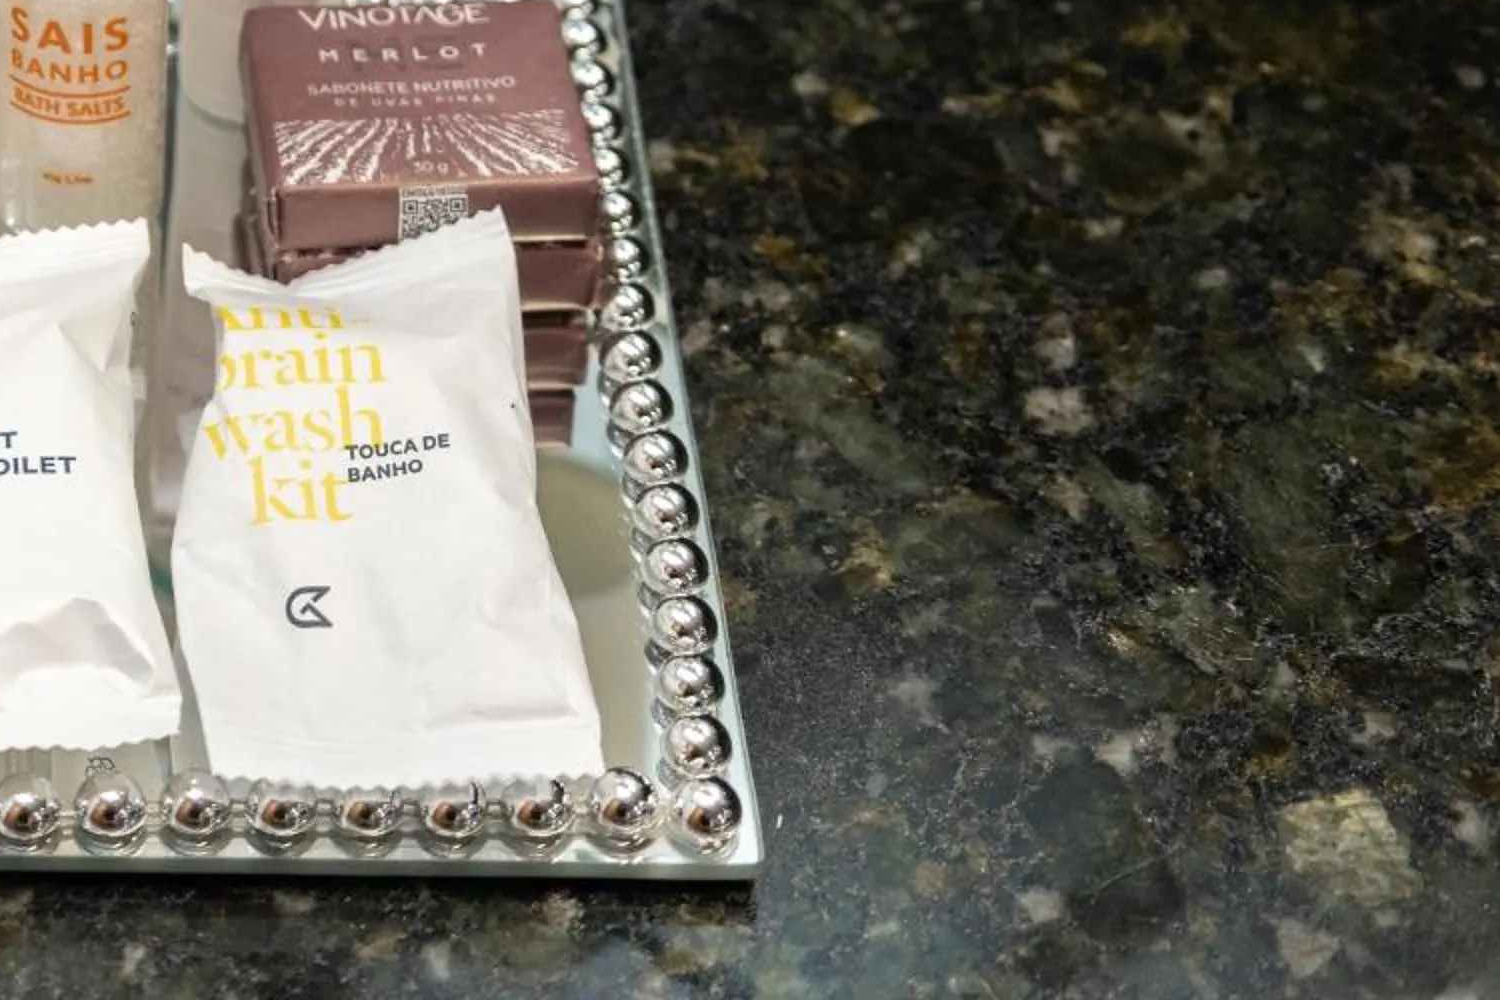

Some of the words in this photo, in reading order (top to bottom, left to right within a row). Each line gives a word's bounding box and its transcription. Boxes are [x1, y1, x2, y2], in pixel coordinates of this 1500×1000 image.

[10, 6, 130, 55] SAIS
[297, 3, 490, 31] VINOTAGE
[10, 48, 129, 84] BANHO
[318, 42, 486, 62] MERLOT
[307, 81, 409, 97] SABONETE
[413, 75, 517, 93] NUTRITIVO
[14, 87, 59, 114] BATH
[67, 96, 124, 117] SALTS
[204, 385, 384, 461] wash
[344, 439, 419, 461] TOUCA
[422, 433, 451, 450] DE
[347, 458, 424, 483] BANHO
[247, 455, 353, 527] kit
